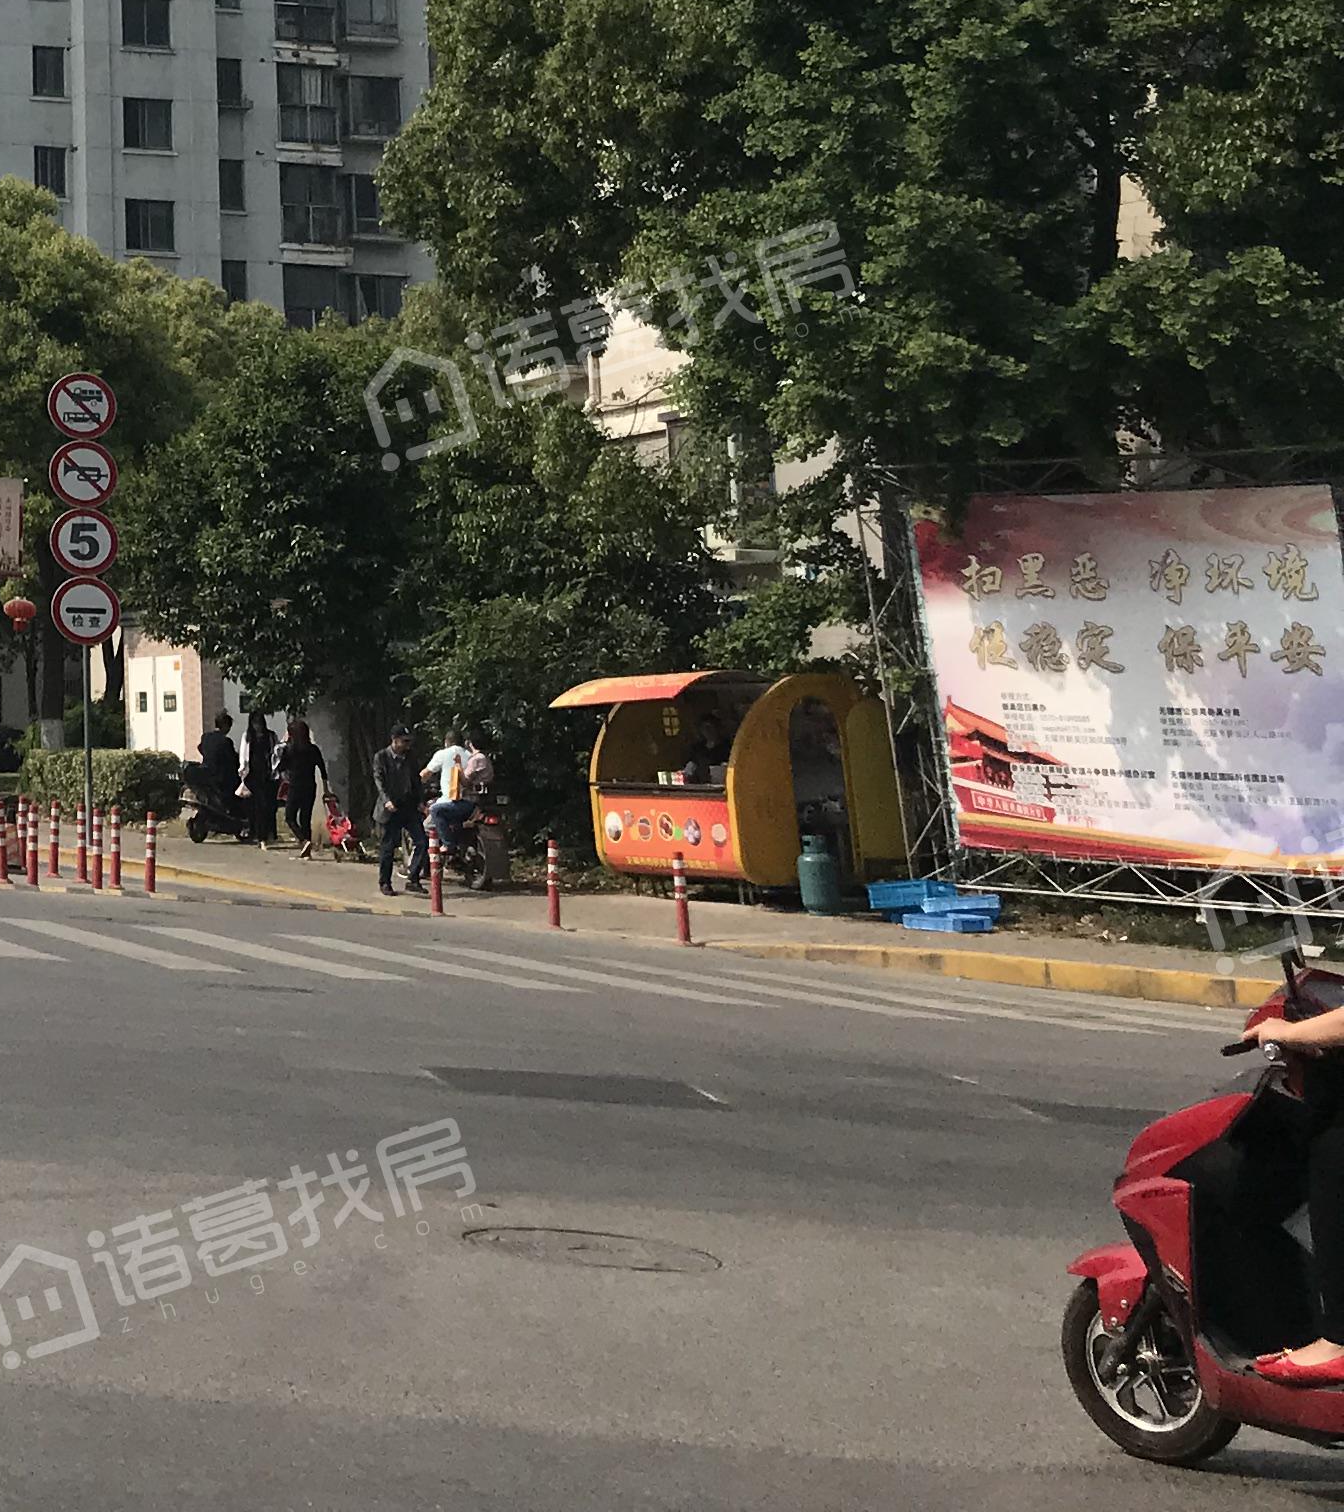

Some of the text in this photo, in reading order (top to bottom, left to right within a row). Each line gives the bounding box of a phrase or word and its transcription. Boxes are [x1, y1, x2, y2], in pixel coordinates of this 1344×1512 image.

[69, 523, 100, 561] 5
[958, 542, 1320, 605] 扫黑恶 净环境
[72, 615, 101, 628] 检查
[1156, 621, 1326, 678] 保平安
